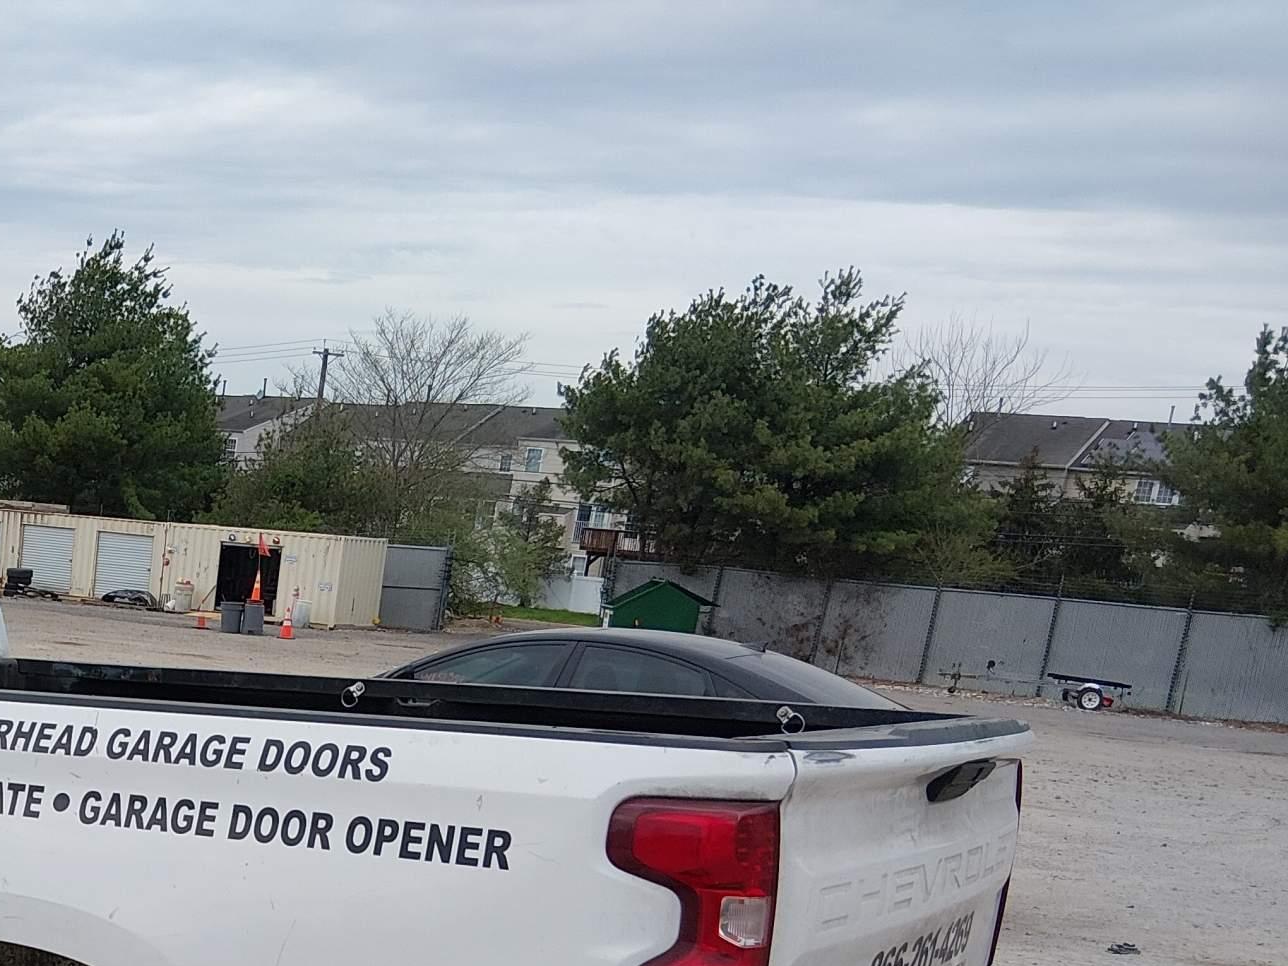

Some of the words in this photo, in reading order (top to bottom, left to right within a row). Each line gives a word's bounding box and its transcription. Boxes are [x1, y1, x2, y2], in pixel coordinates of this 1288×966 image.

[106, 727, 251, 770] GARAGE
[257, 739, 392, 783] DOORS
[78, 791, 219, 837] GARAGE
[227, 803, 334, 850] DOOR
[344, 815, 512, 871] OPENER
[818, 831, 1016, 929] CHEVROLE
